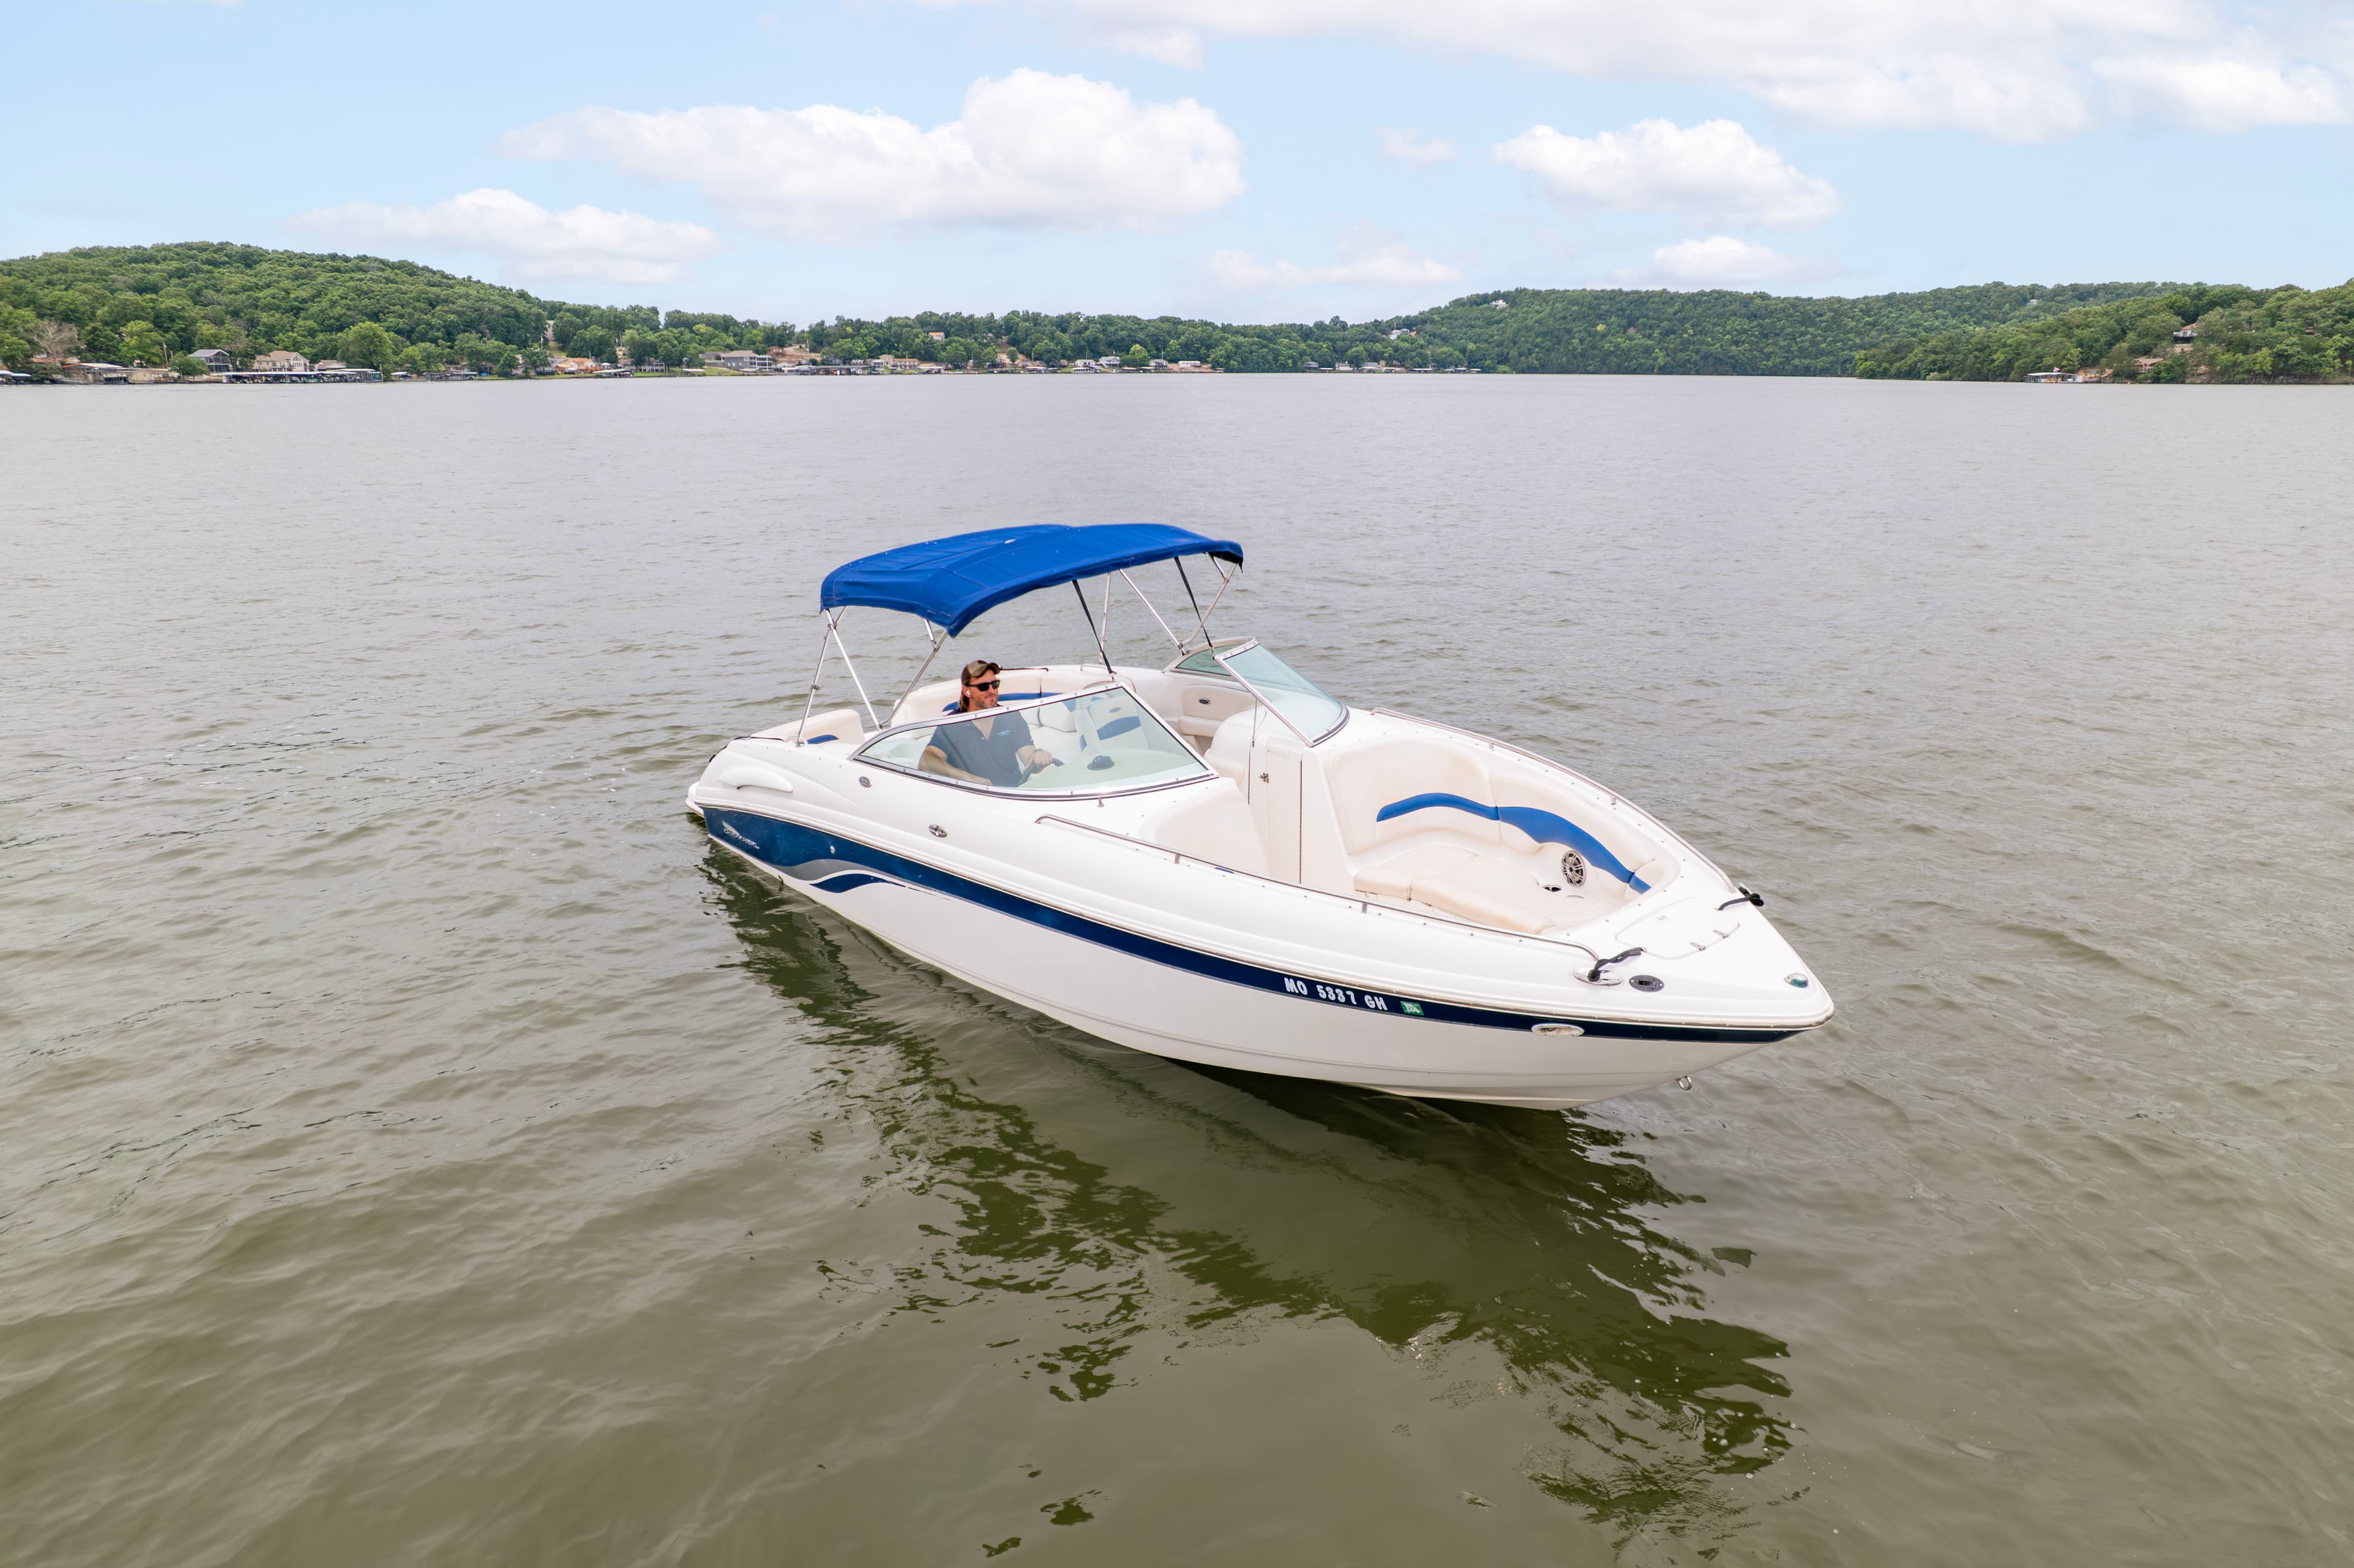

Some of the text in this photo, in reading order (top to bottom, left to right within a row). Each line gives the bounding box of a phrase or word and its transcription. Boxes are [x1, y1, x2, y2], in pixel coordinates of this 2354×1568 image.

[1284, 977, 1388, 1011] MO 5337 GH
